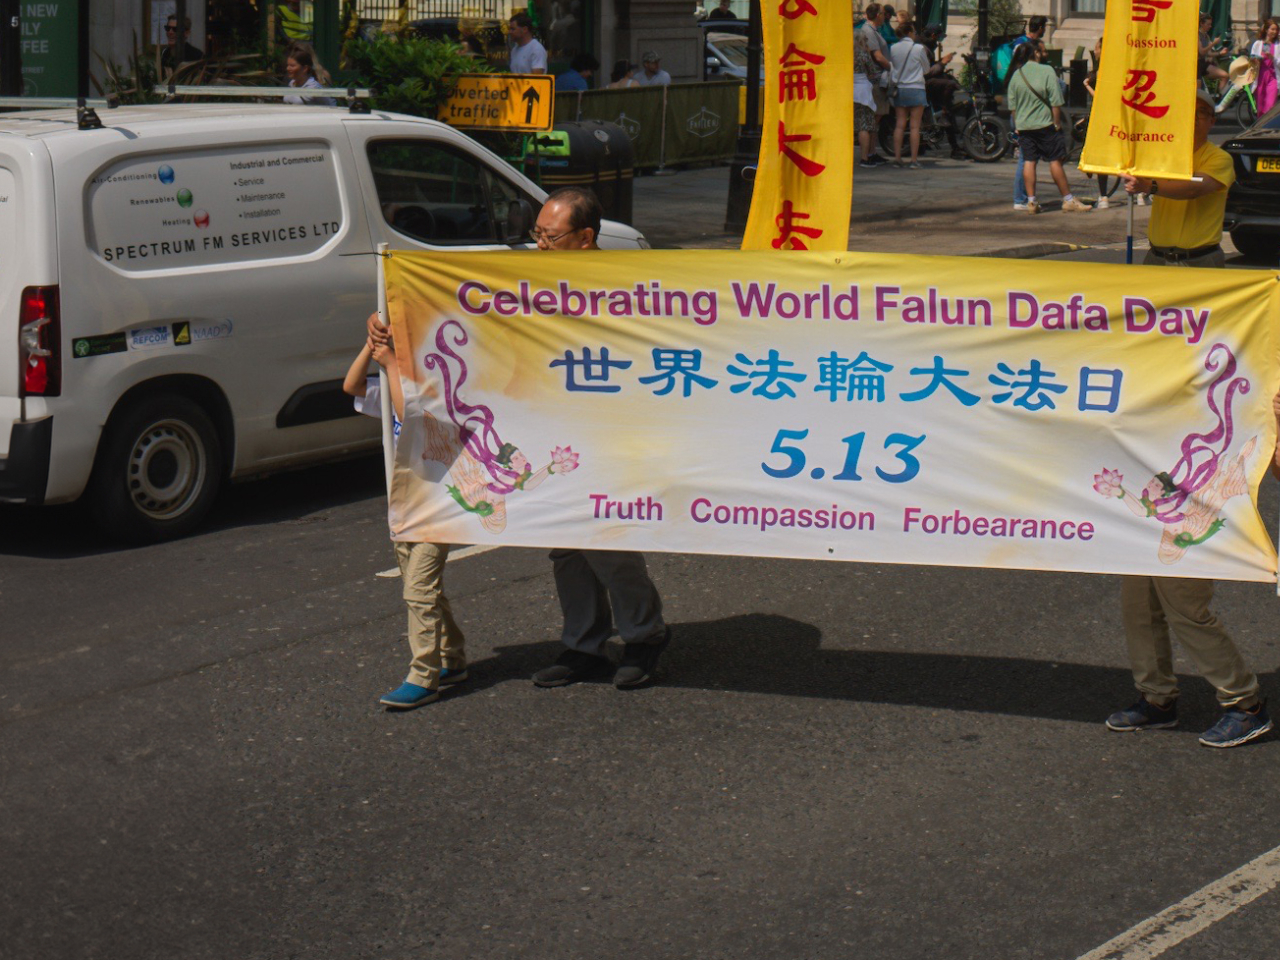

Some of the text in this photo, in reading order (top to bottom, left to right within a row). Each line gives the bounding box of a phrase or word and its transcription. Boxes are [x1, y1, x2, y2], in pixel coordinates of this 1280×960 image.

[26, 3, 59, 18] NEW
[21, 22, 42, 36] ILY
[21, 40, 49, 54] FEE
[450, 104, 500, 119] traffic
[230, 154, 325, 171] Industrial and Commercial
[91, 171, 158, 184] Air-Conditioning
[238, 176, 265, 186] Service
[130, 195, 175, 206] Renewables
[240, 191, 286, 203] Maintenance
[243, 208, 281, 219] Installation
[162, 217, 191, 228] Heating
[103, 221, 341, 262] SPECTRUM FM SERVICES LTD
[458, 281, 1211, 344] Celebrating World Falun Dafa Day
[133, 333, 168, 345] REFCOM
[549, 346, 1124, 414] 世界法輪大法日
[761, 427, 928, 484] 5.13
[588, 494, 1096, 541] Truth Compassion Forbearance
